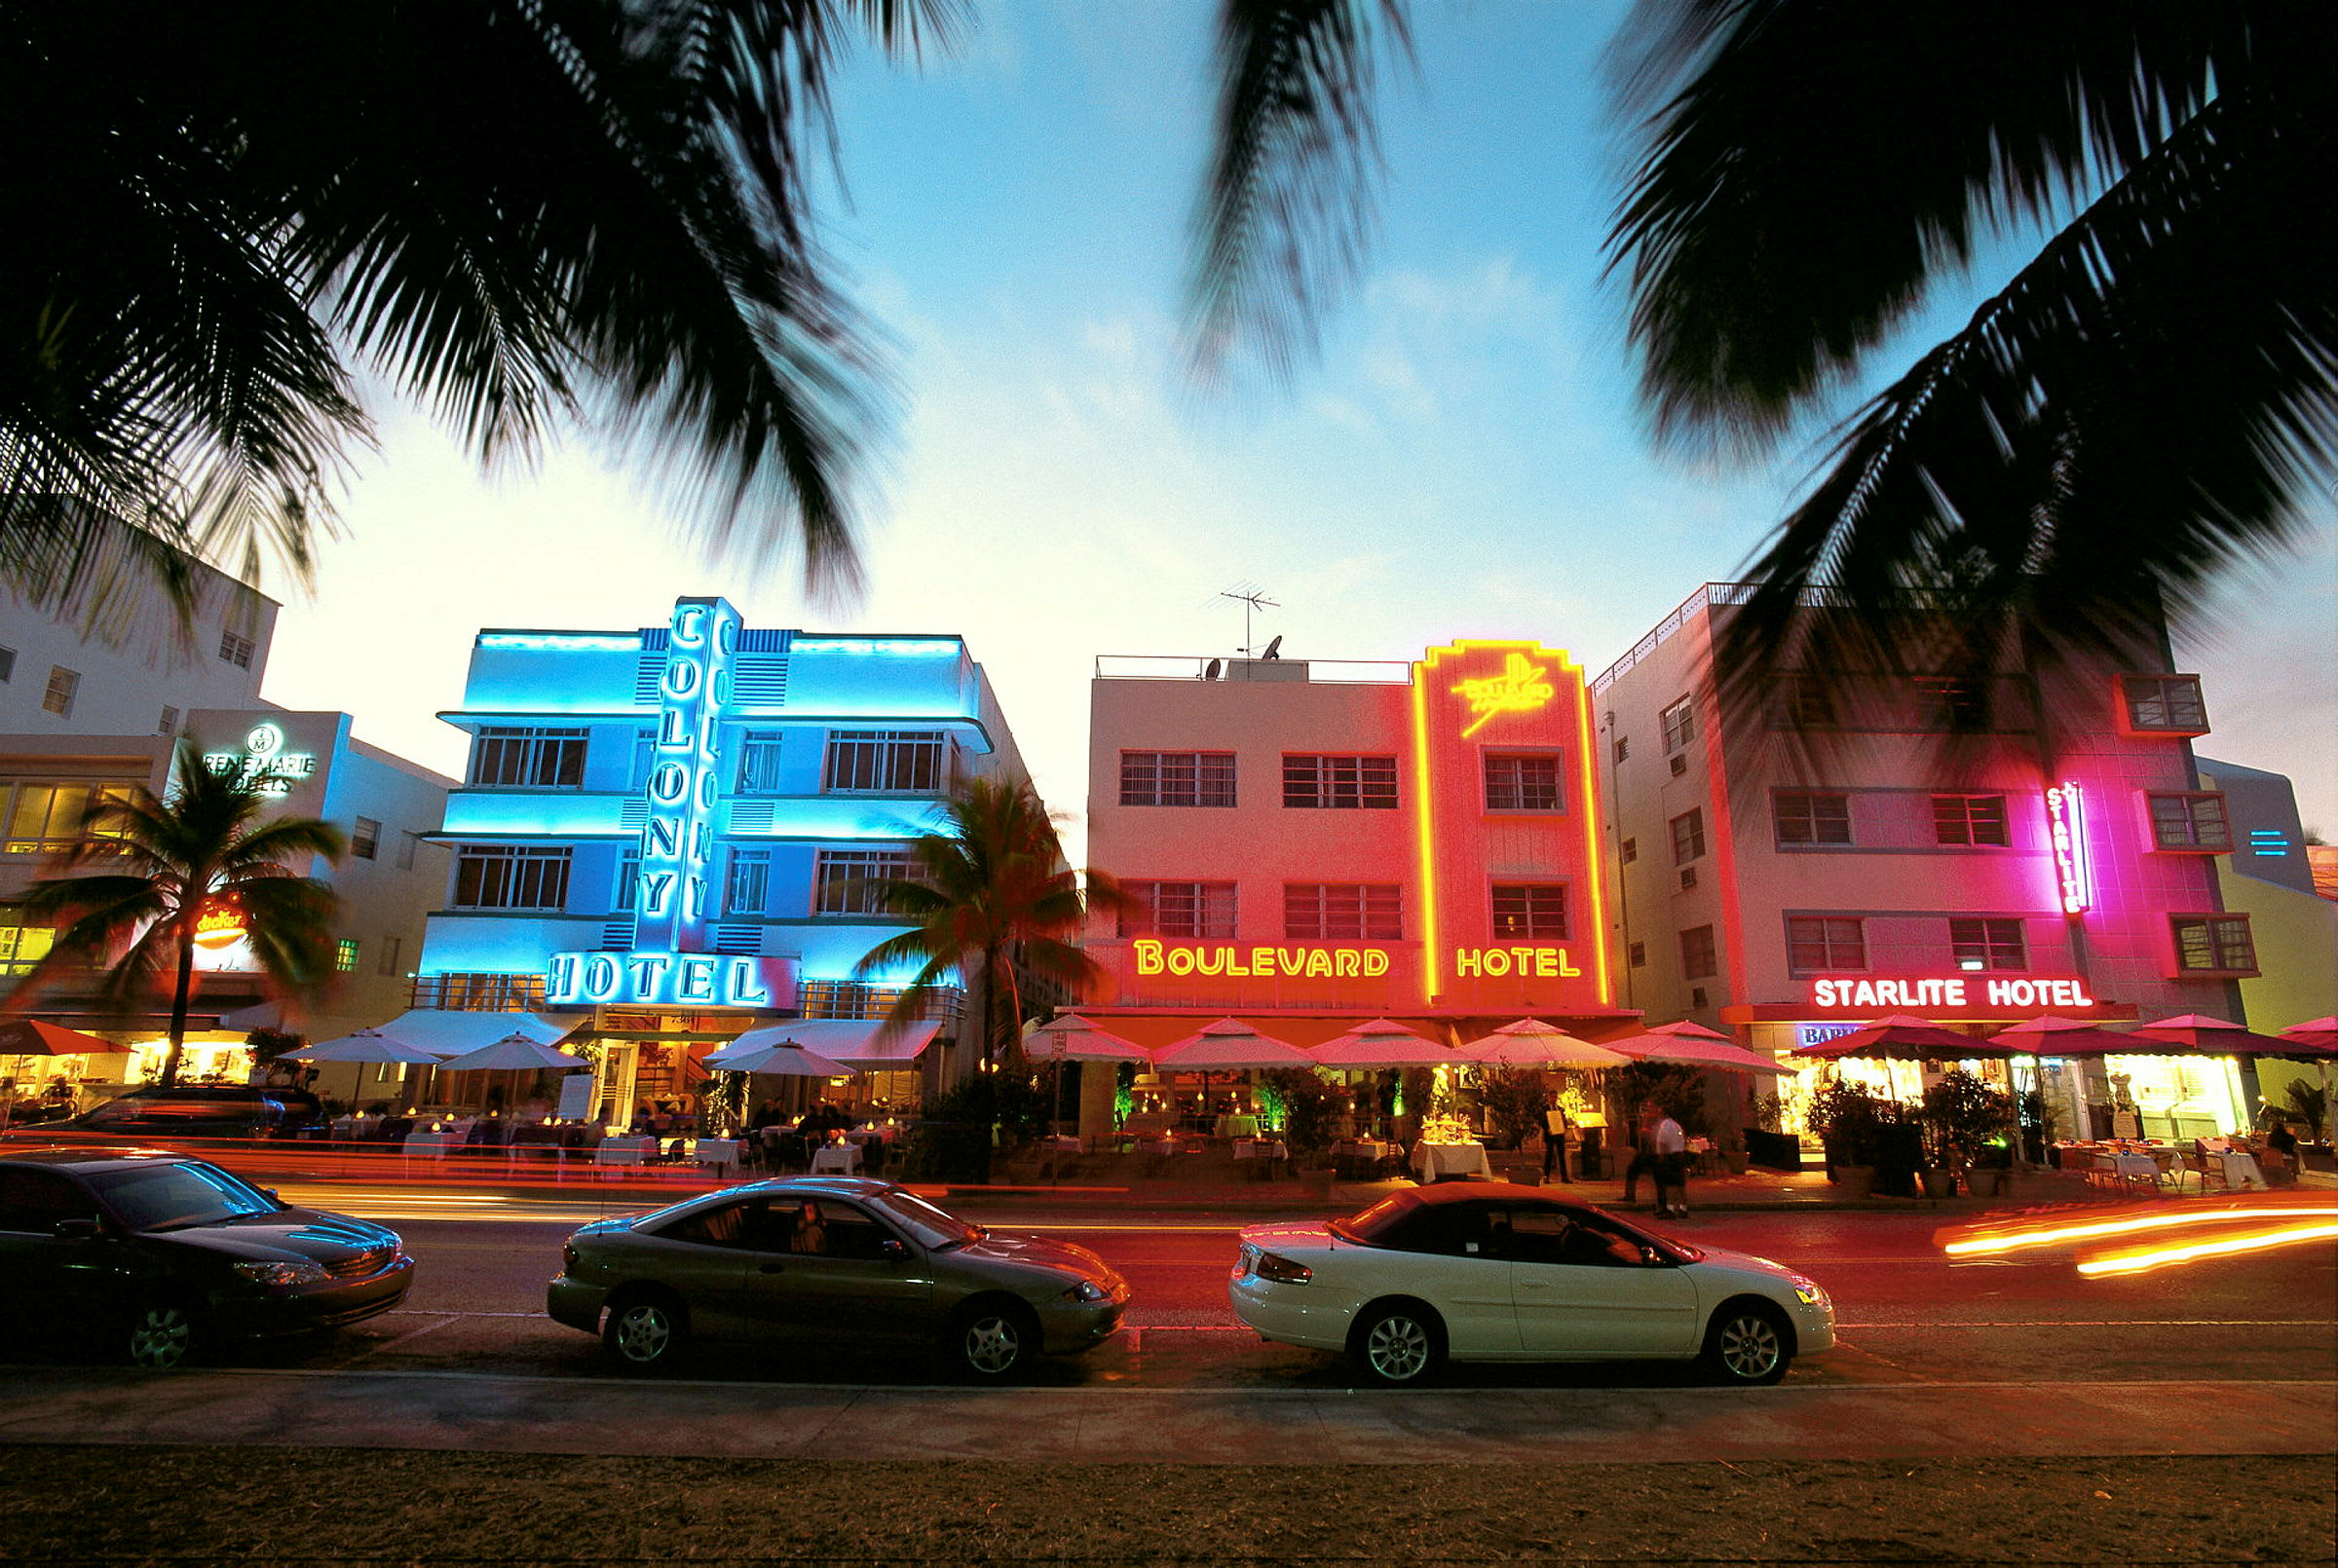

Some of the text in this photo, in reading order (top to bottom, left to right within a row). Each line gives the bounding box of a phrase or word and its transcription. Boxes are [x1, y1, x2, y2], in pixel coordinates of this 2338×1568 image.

[643, 607, 703, 912] COLONY
[691, 619, 735, 917] COLONY
[2047, 787, 2081, 914] STARLITE
[545, 956, 767, 1003] HOTEL
[1134, 940, 1581, 978] BOULEVARD HOTEL
[1814, 979, 2093, 1007] STARLITE HOTEL
